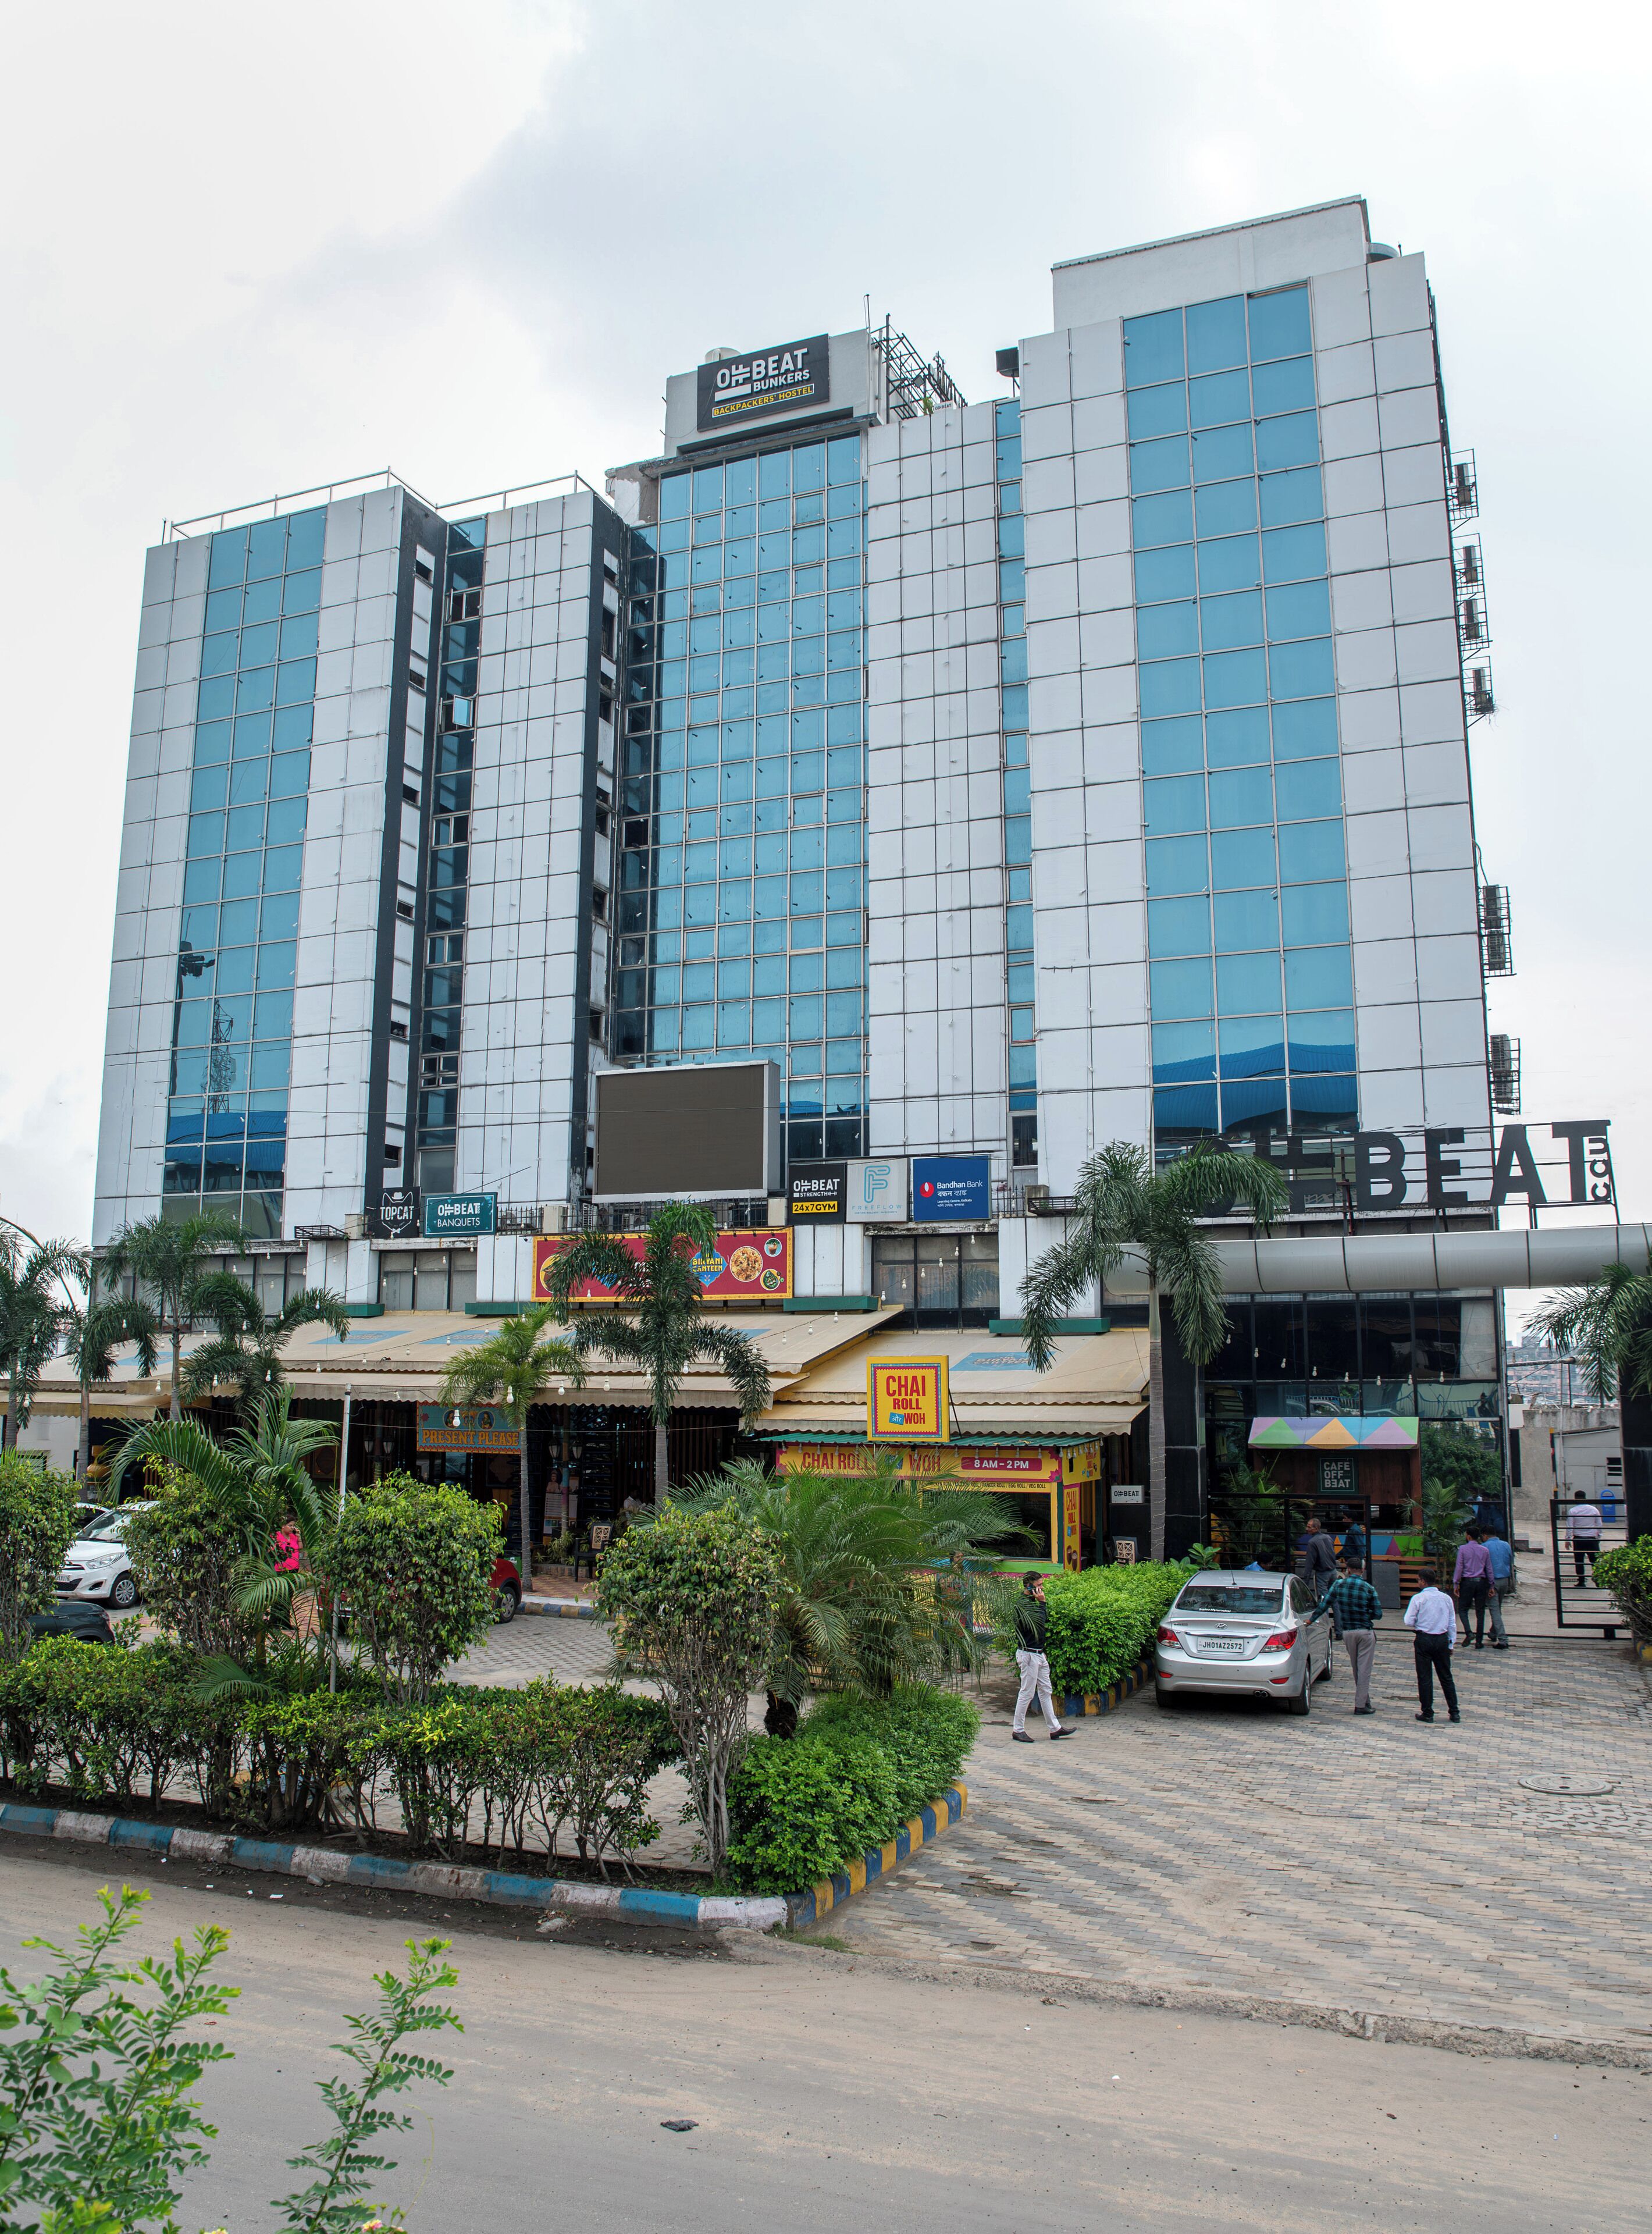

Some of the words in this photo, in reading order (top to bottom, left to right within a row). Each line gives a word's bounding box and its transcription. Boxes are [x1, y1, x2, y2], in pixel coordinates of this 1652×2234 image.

[753, 369, 810, 392] BUNKERS
[714, 394, 777, 416] BACKPACKERS'
[779, 386, 813, 400] HOSTEL
[937, 1181, 966, 1189] Bandhan
[380, 1205, 414, 1221] TOPCAT
[437, 1217, 480, 1228] BANQUETS
[886, 1375, 926, 1397] CHAI
[893, 1398, 922, 1410] ROLL
[891, 1414, 902, 1423] और
[904, 1413, 925, 1424] WOH
[422, 1429, 476, 1445] PRESENT
[478, 1430, 519, 1446] PLEASE
[802, 1452, 834, 1470] CHAI
[974, 1460, 980, 1468] 8
[982, 1460, 998, 1468] AM
[1014, 1461, 1029, 1469] PM
[1324, 1471, 1344, 1479] OFF
[1066, 1490, 1077, 1511] CHAI
[1202, 1641, 1242, 1650] JH01AZ2572
